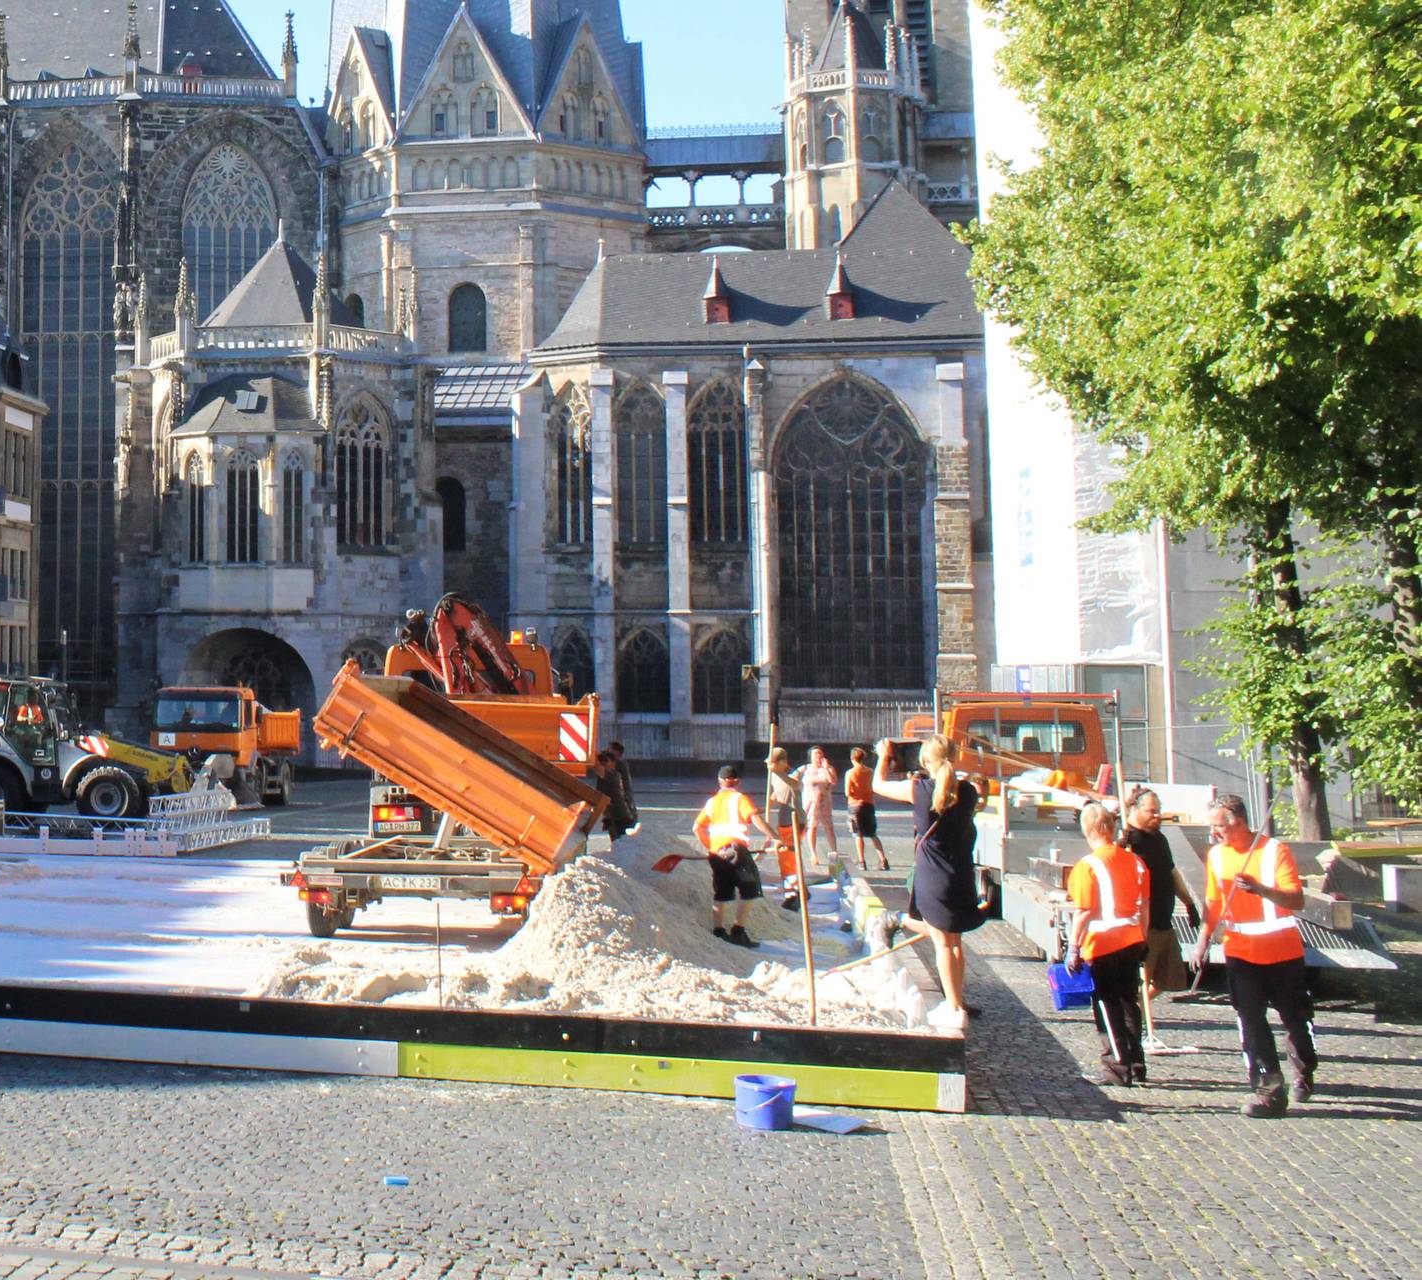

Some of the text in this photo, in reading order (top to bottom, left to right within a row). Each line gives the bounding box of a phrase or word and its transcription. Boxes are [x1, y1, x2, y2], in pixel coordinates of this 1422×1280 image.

[163, 735, 171, 745] A
[379, 823, 389, 831] AC
[384, 877, 439, 888] AC K 232
